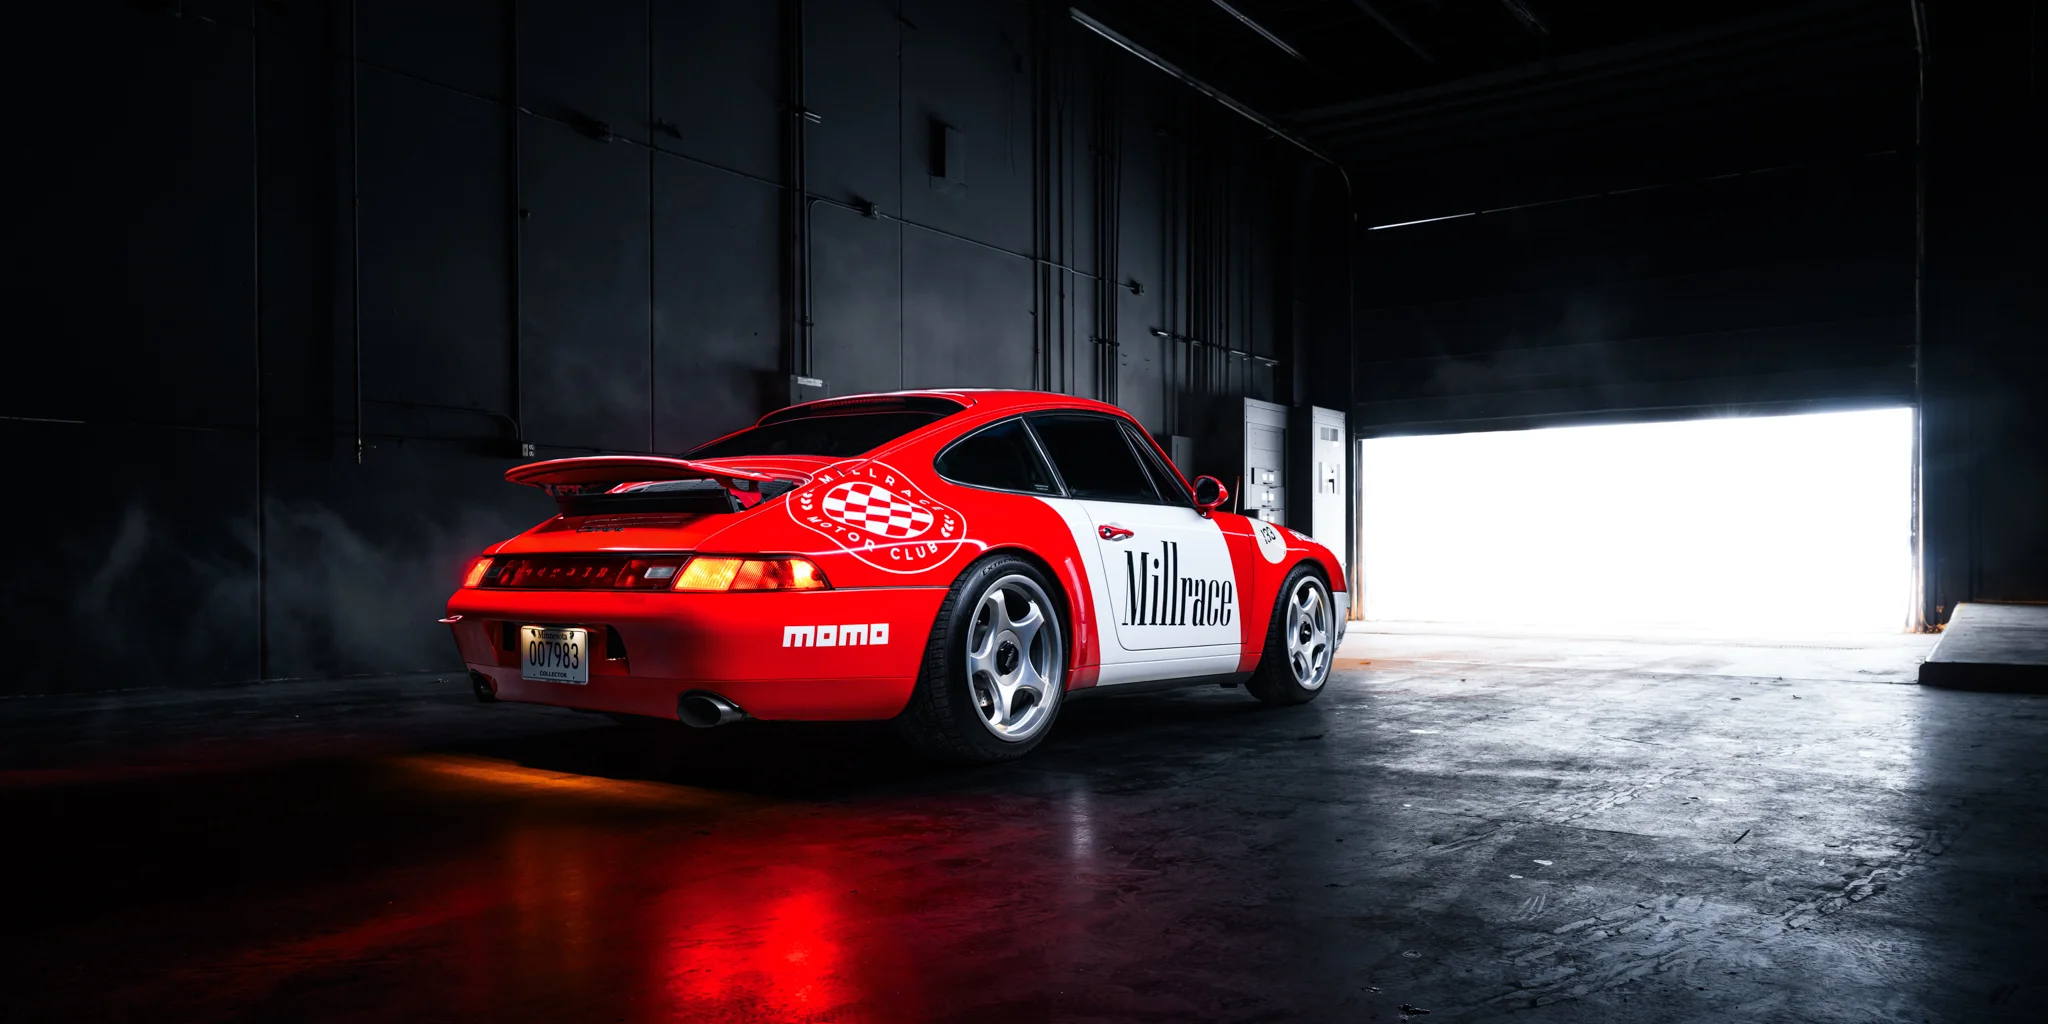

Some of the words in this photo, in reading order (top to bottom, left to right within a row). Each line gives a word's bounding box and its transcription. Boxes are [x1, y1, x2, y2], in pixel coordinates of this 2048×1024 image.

[818, 468, 943, 511] MILLRACE
[807, 516, 875, 552] MOTOR
[890, 541, 938, 560] CLUB
[1122, 540, 1233, 626] Millrace
[537, 630, 567, 640] Minnesota
[529, 640, 579, 669] 007983
[539, 670, 567, 678] COLLECTOR
